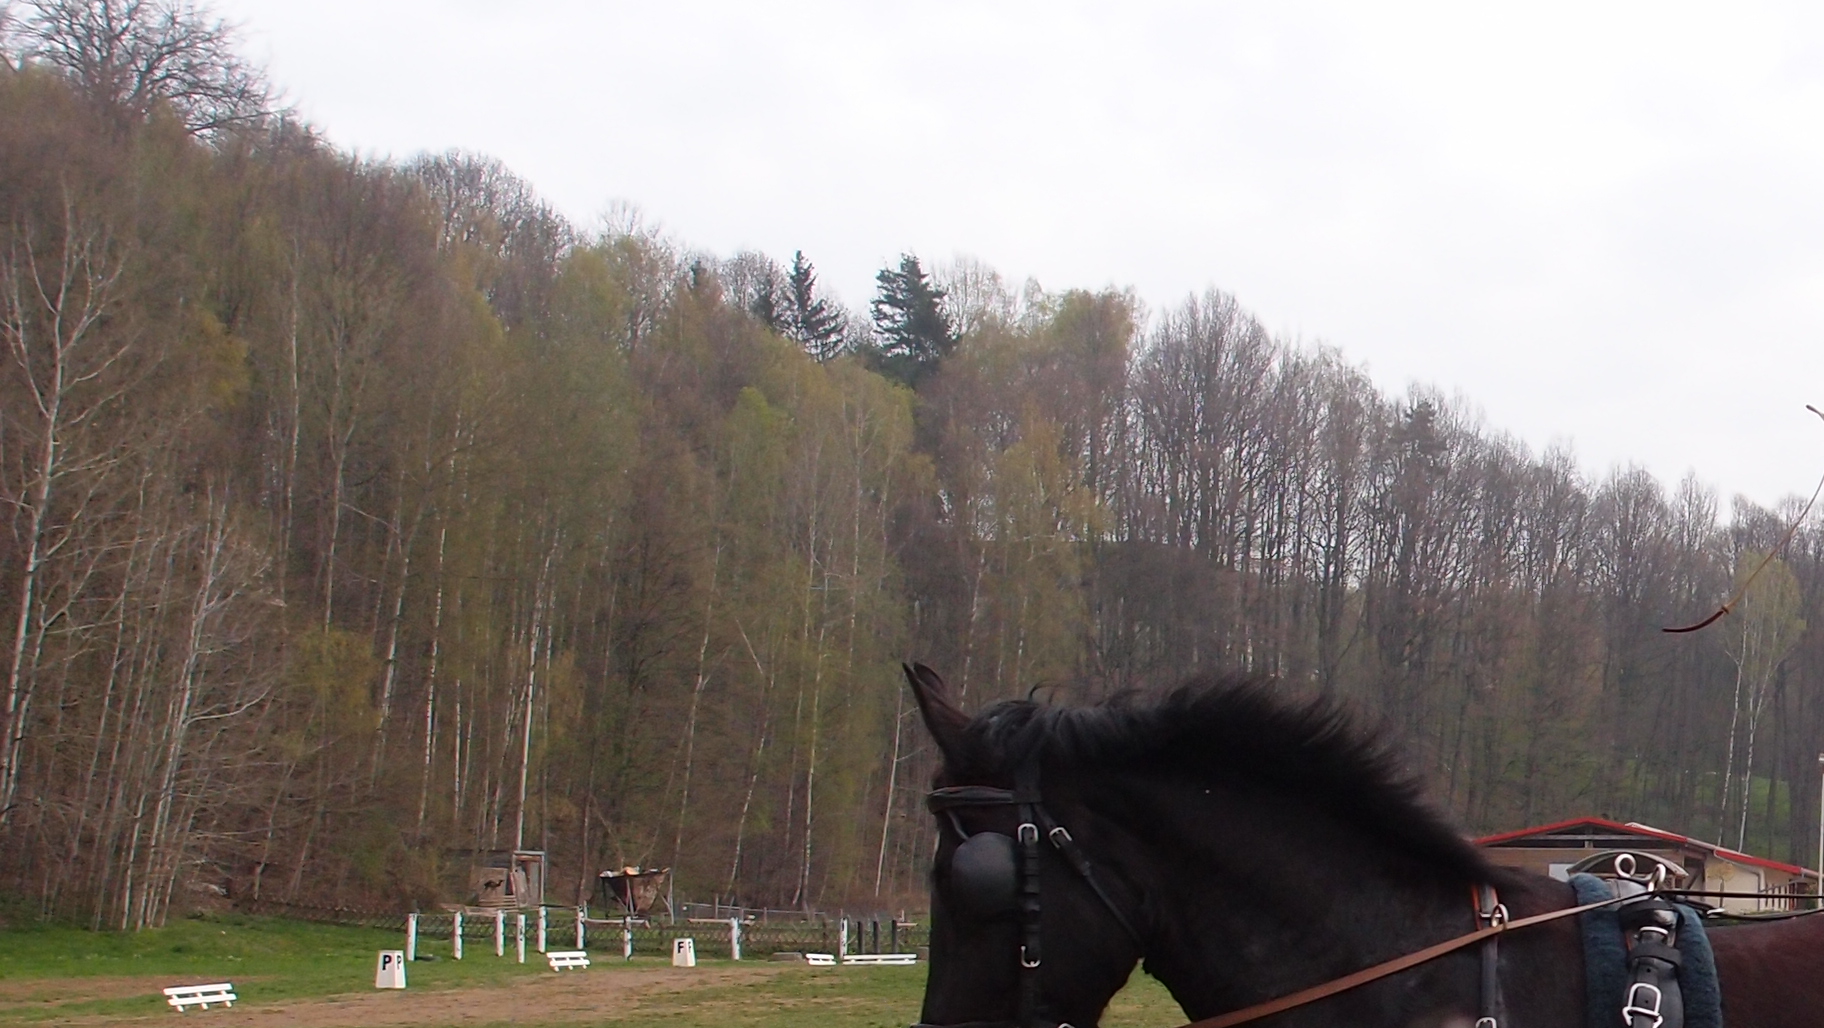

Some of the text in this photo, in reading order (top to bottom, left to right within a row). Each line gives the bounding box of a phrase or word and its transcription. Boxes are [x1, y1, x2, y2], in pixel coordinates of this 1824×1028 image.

[678, 941, 684, 953] F
[382, 954, 392, 971] P
[397, 955, 402, 970] P
